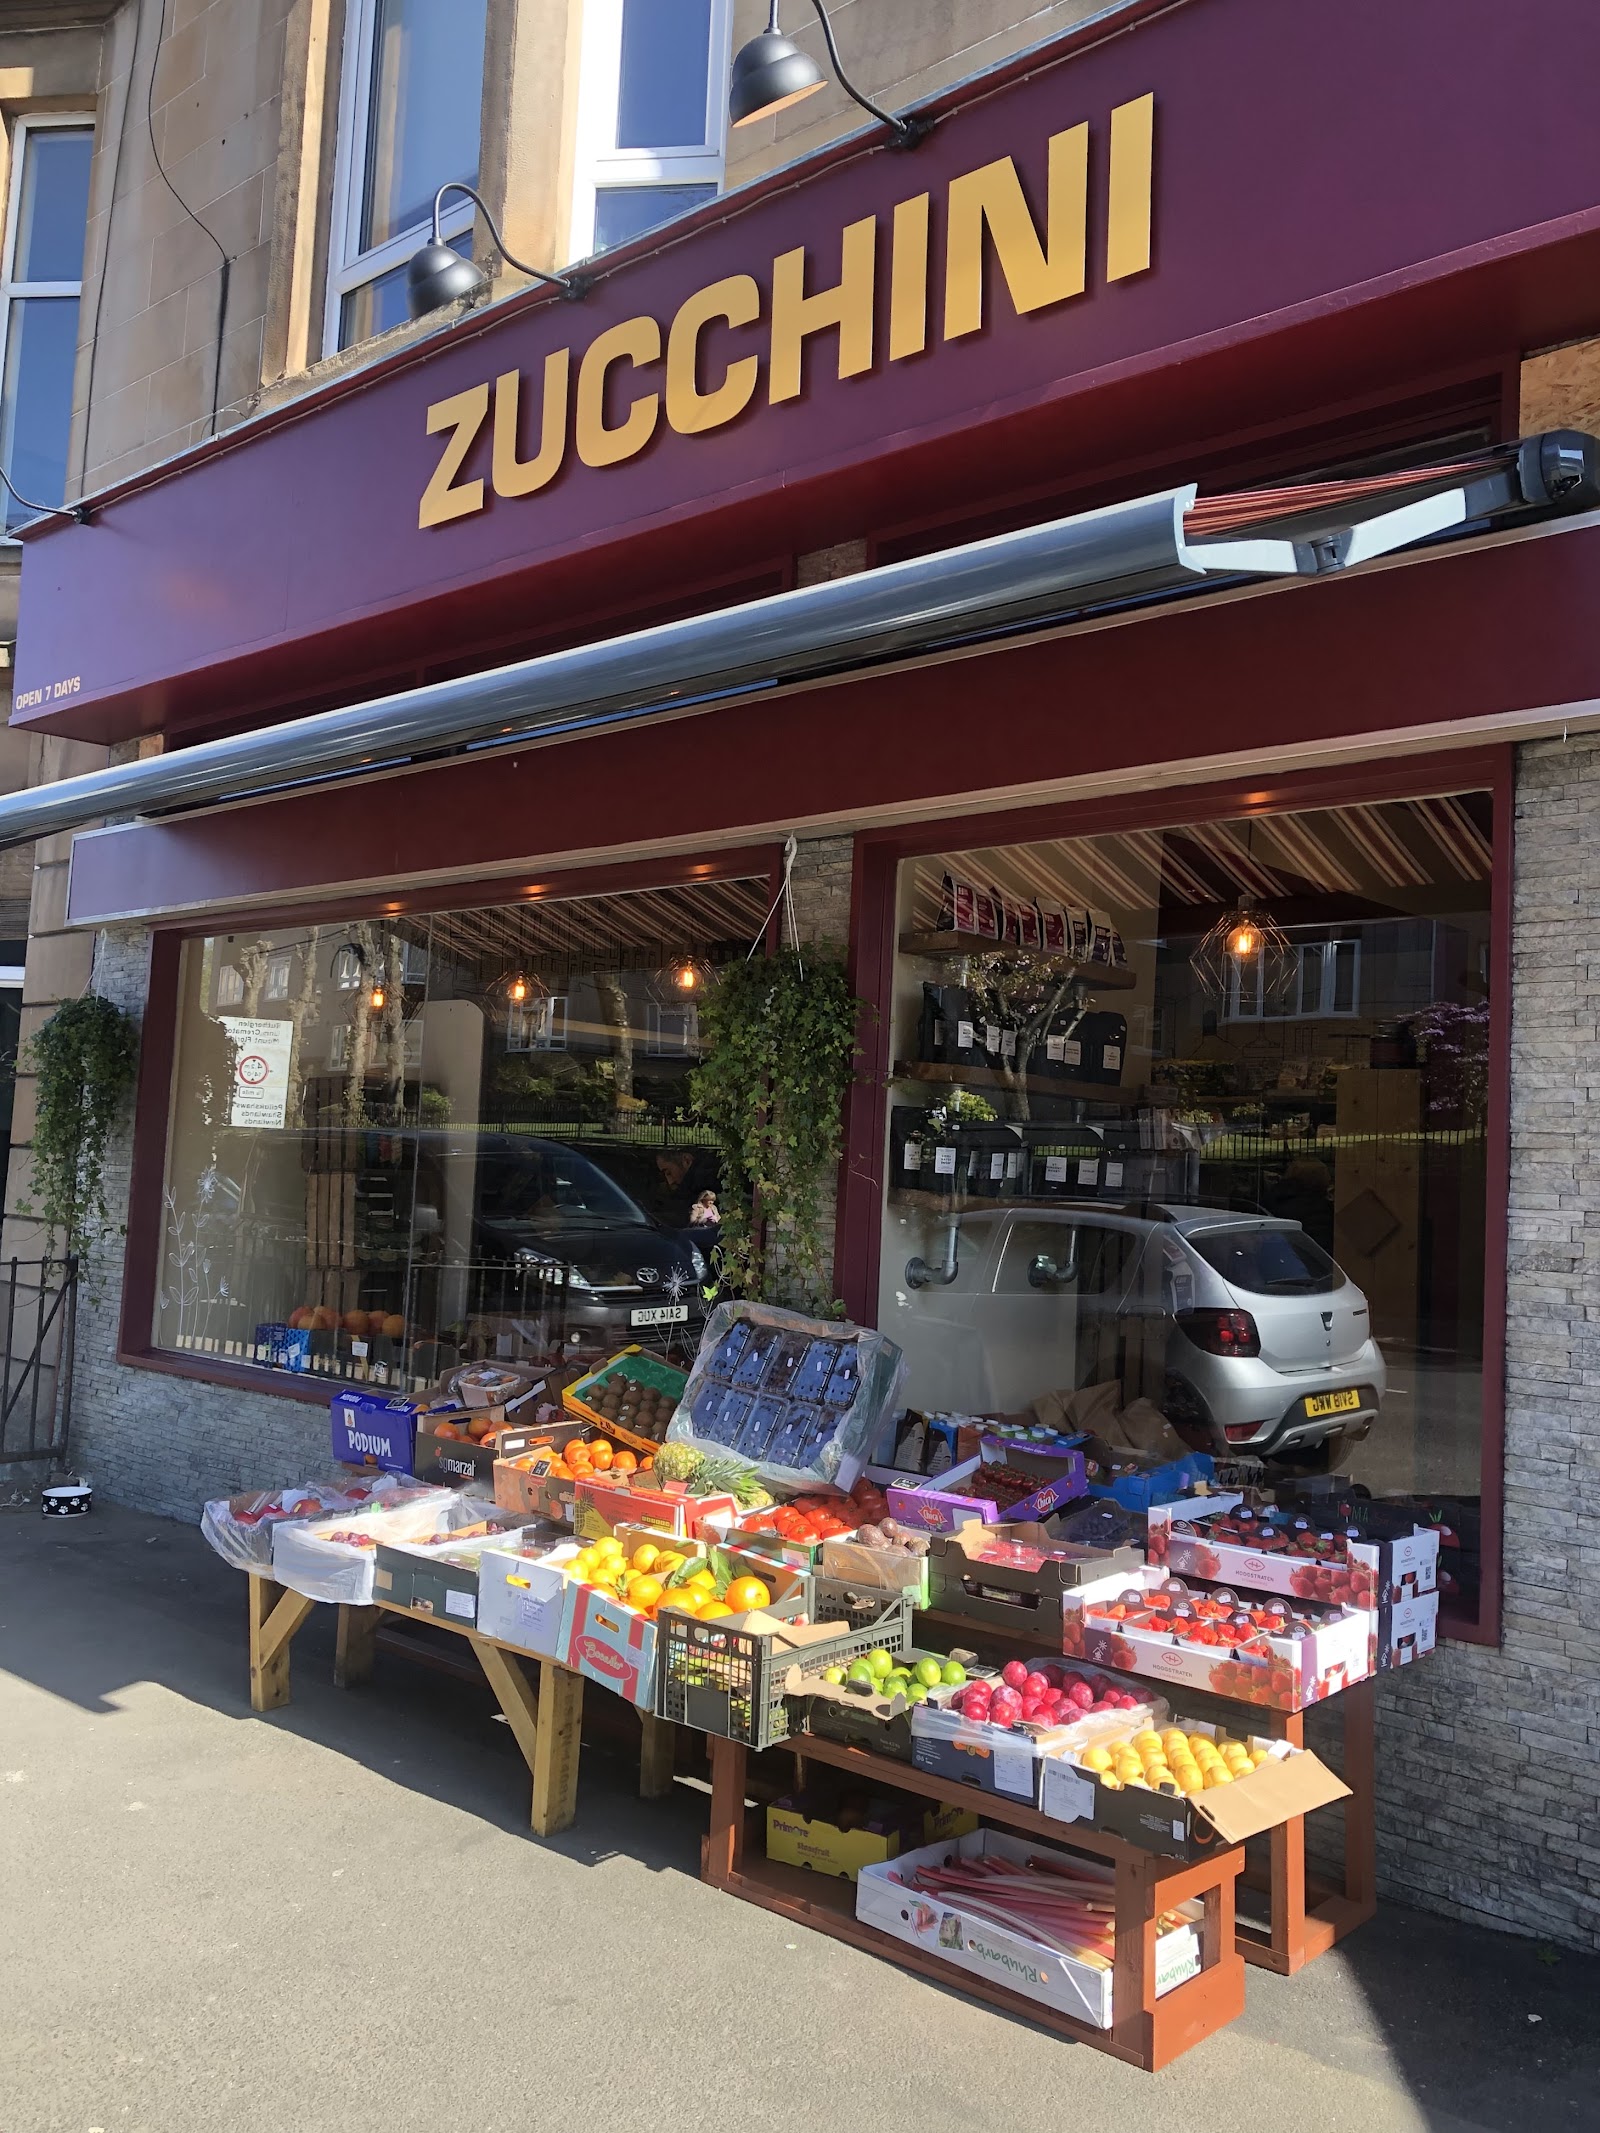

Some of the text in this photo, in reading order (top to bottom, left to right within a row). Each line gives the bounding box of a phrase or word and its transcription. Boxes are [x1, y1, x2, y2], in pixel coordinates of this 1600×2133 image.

[419, 91, 1154, 529] ZUCCHINI
[16, 676, 81, 710] OPEN 7 DAYS
[347, 1429, 392, 1458] PODIUM
[1235, 1570, 1275, 1582] HOOGSTRATEN
[1152, 1664, 1193, 1678] HOOGSTRATEN
[976, 1943, 1038, 1983] Rhubarb
[1156, 1957, 1195, 1986] Rhubar
